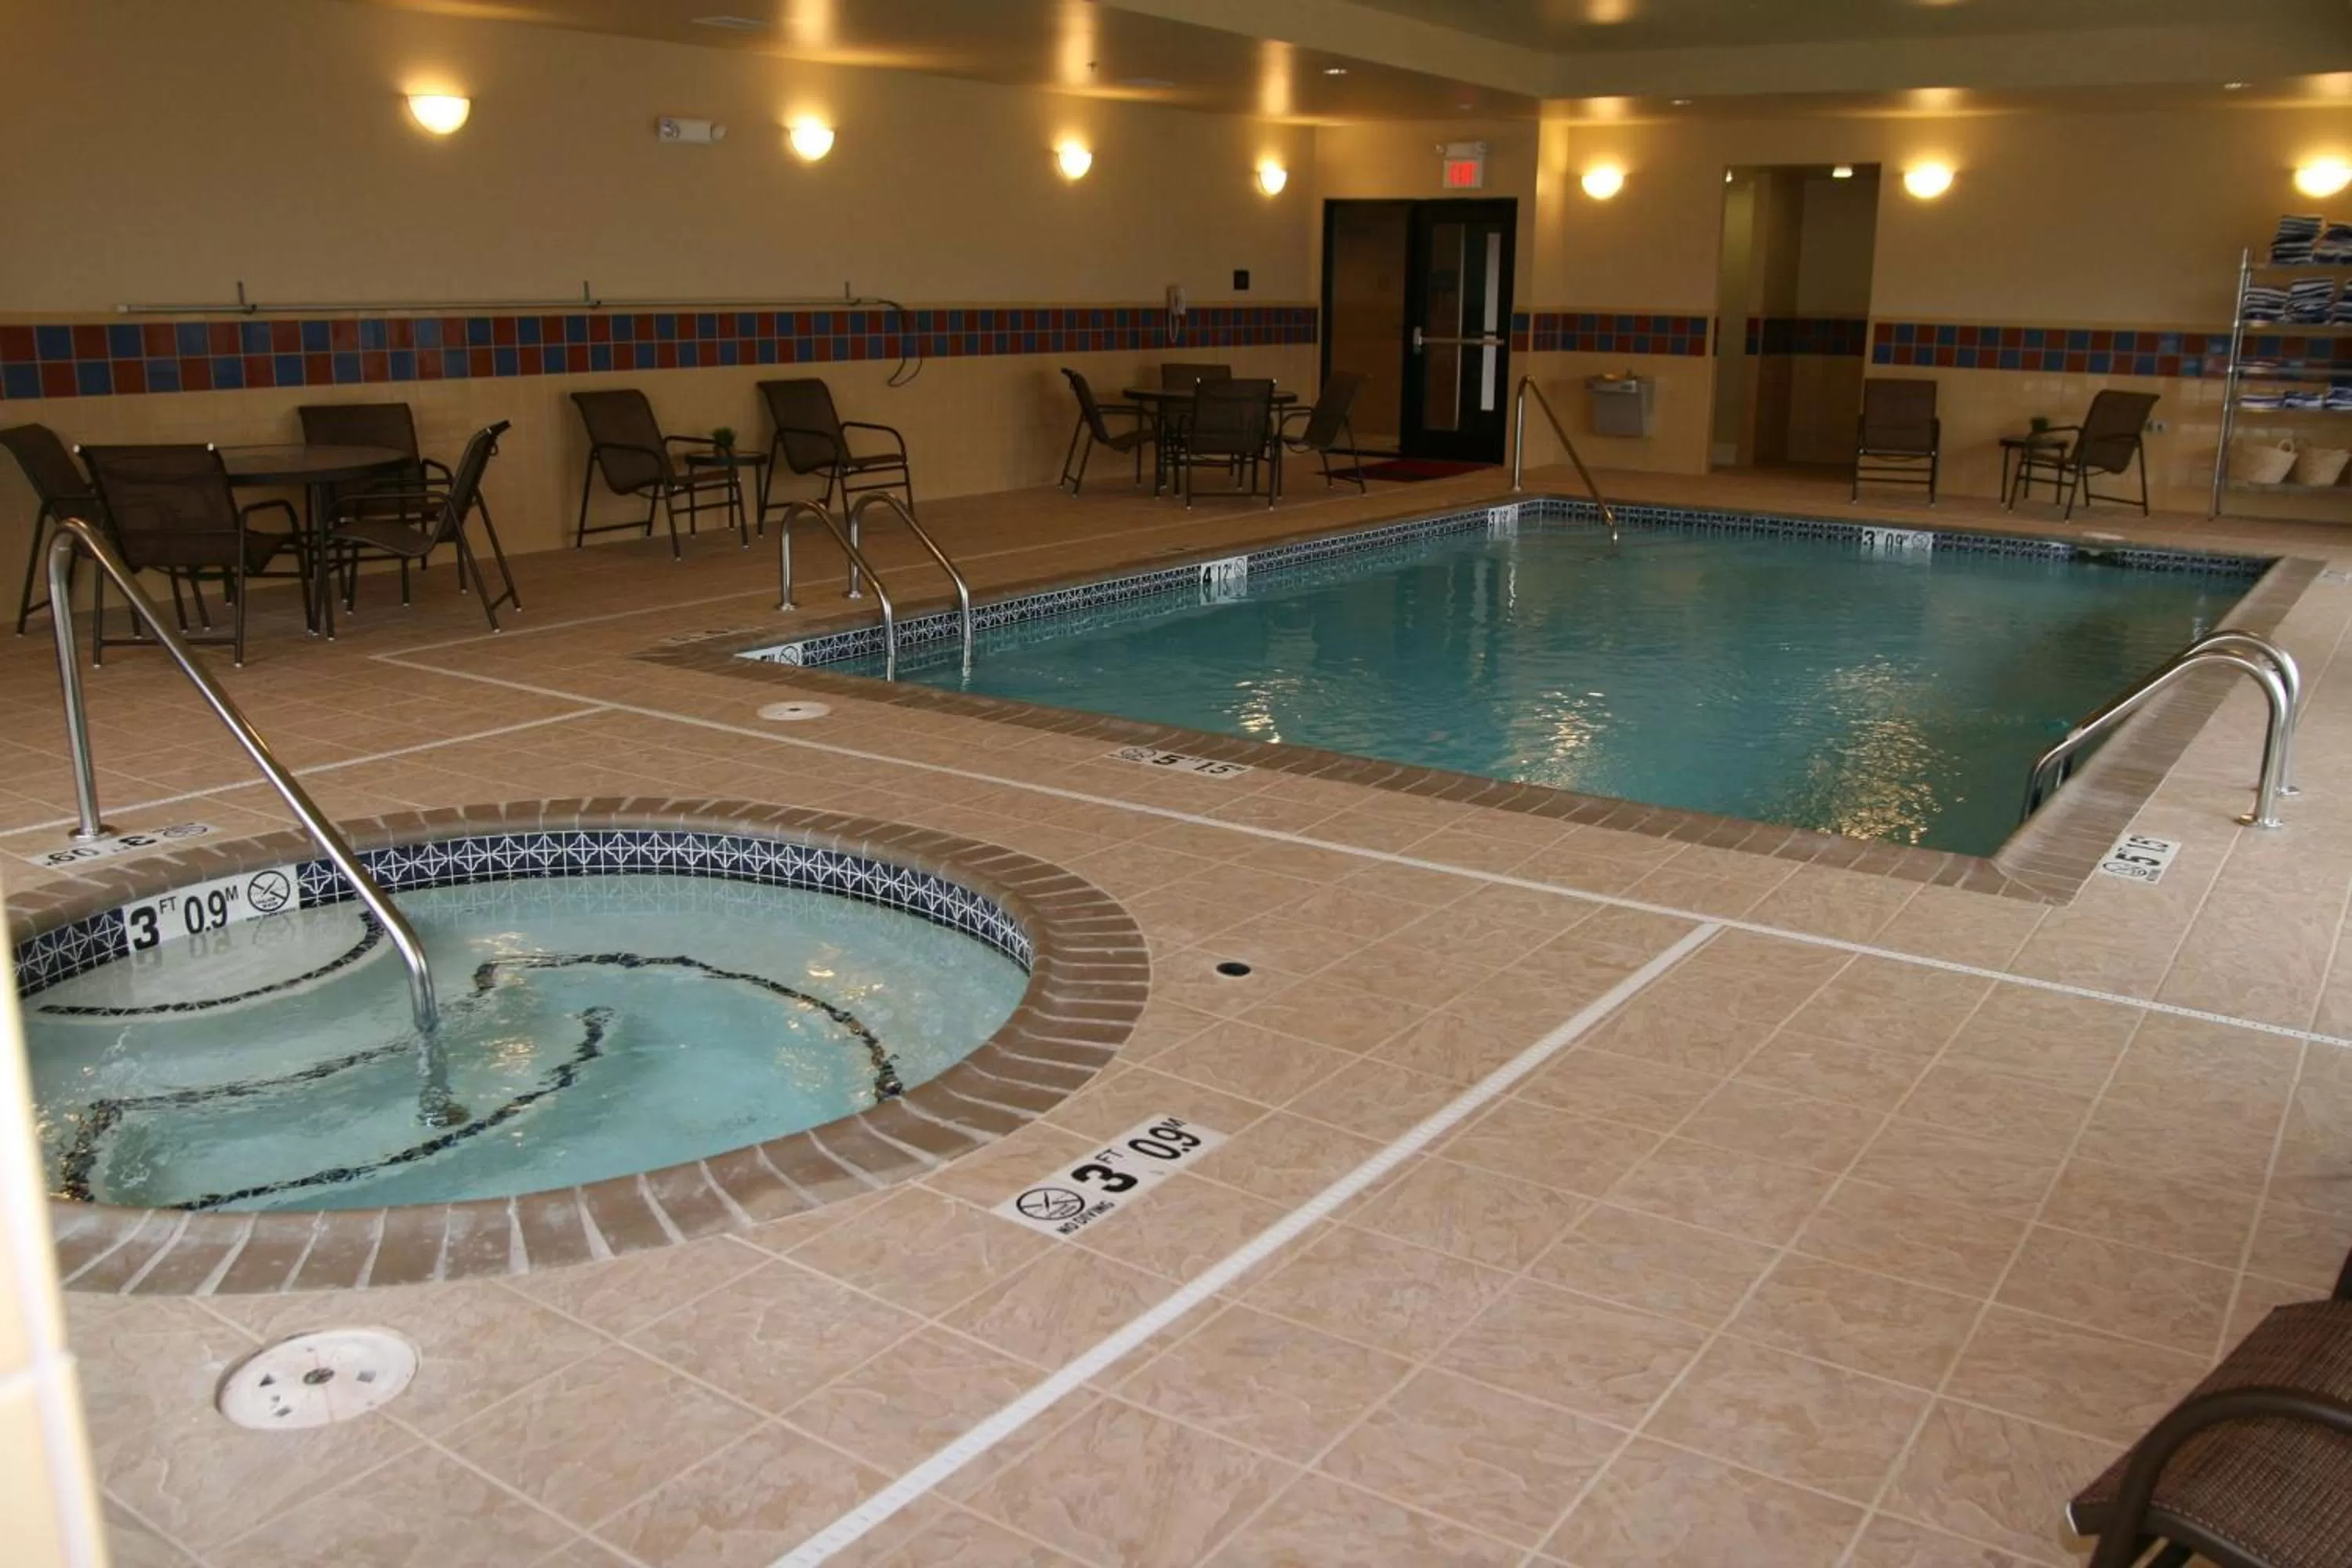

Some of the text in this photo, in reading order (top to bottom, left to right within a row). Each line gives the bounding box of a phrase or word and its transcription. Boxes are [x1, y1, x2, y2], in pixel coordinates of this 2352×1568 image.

[1152, 754, 1187, 765] 5
[130, 906, 160, 950] 3
[184, 890, 227, 935] 0.9
[1071, 1163, 1138, 1193] 3
[1128, 1126, 1201, 1160] 0.9
